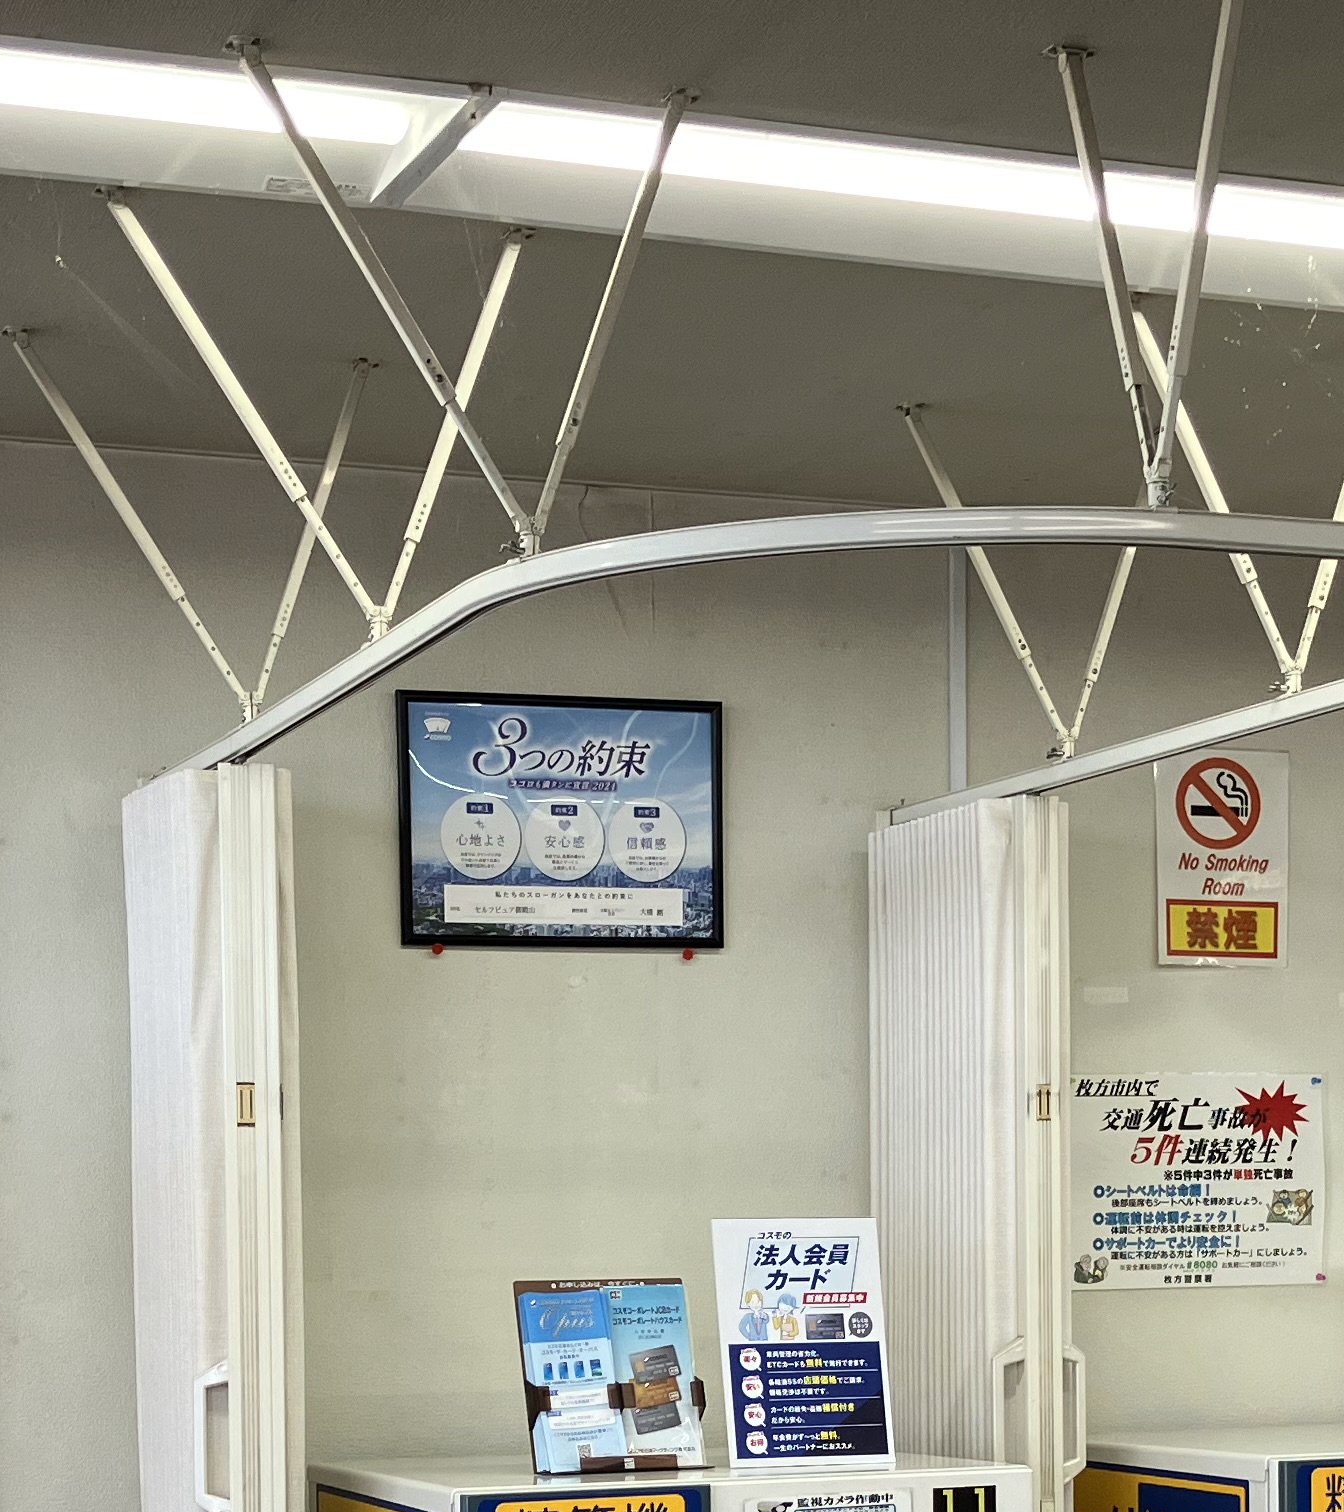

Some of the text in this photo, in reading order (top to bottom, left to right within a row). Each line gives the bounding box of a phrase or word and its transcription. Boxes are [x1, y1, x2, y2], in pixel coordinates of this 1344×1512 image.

[472, 717, 650, 778] 3つの約束
[456, 834, 506, 847] 心地よさ
[544, 835, 585, 849] 安心感
[626, 837, 667, 850] 信頼感
[1178, 852, 1269, 875] No Smoking
[1202, 877, 1245, 897] Room
[1186, 907, 1259, 950] 禁煙
[1075, 1078, 1159, 1097] 枚方市内で
[1099, 1097, 1270, 1132] 交通死亡事故が
[757, 1231, 792, 1240] コスモの
[753, 1243, 850, 1266] 法人会員
[764, 1268, 832, 1291] カード
[797, 1493, 894, 1508] 監視カメラ作動中
